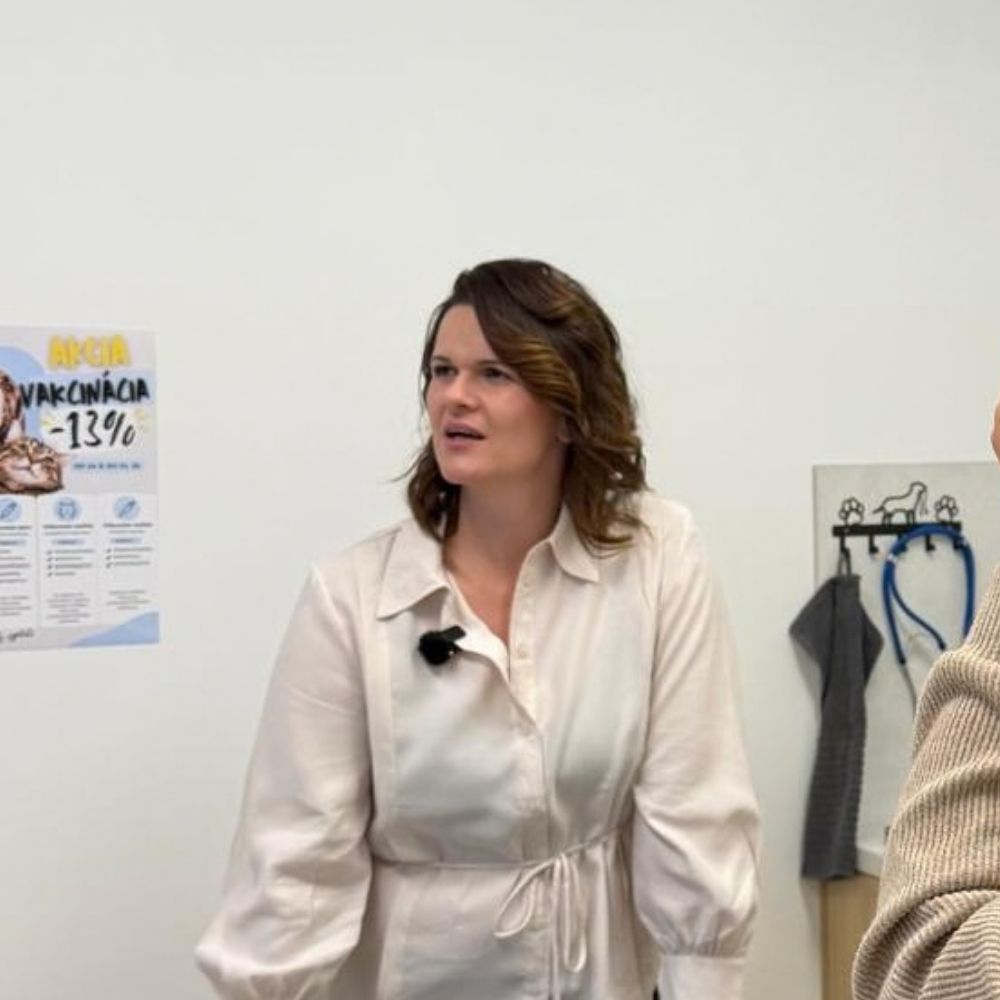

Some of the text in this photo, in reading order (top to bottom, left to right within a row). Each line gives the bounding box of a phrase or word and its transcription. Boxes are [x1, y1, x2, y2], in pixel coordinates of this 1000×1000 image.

[48, 334, 131, 369] AKCIA
[19, 370, 149, 408] VAKCINÁCIA
[50, 410, 136, 449] -13%
